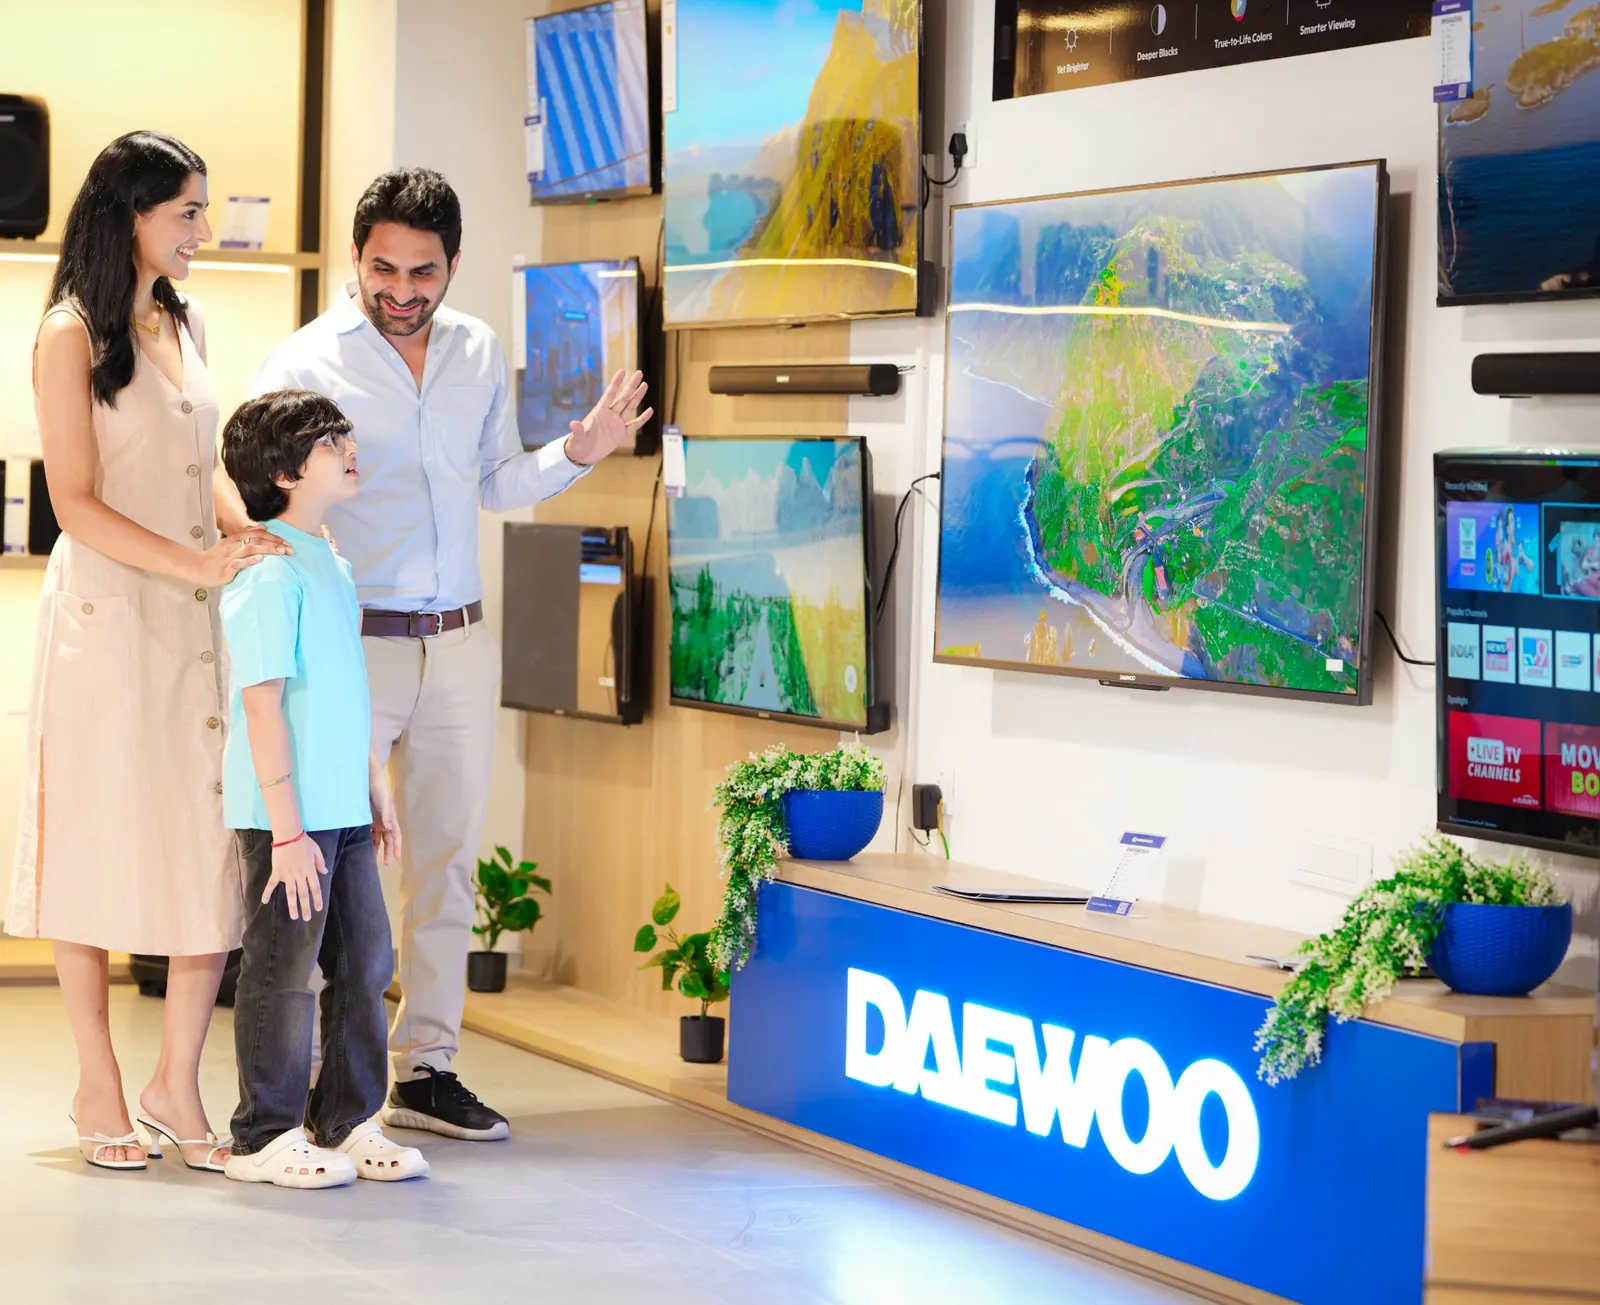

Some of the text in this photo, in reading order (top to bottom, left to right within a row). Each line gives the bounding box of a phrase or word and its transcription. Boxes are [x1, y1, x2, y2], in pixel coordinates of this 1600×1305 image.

[1300, 18, 1356, 36] Smarter Viewing
[1214, 31, 1272, 49] True-to-Life Colors
[1137, 46, 1178, 61] Deeper Blacks
[1056, 62, 1089, 75] Yet Brighter
[1487, 642, 1506, 653] NEWS
[1476, 744, 1521, 764] LIVE TV
[1468, 764, 1521, 783] CHANNELS
[845, 967, 1260, 1201] DAEWOO
